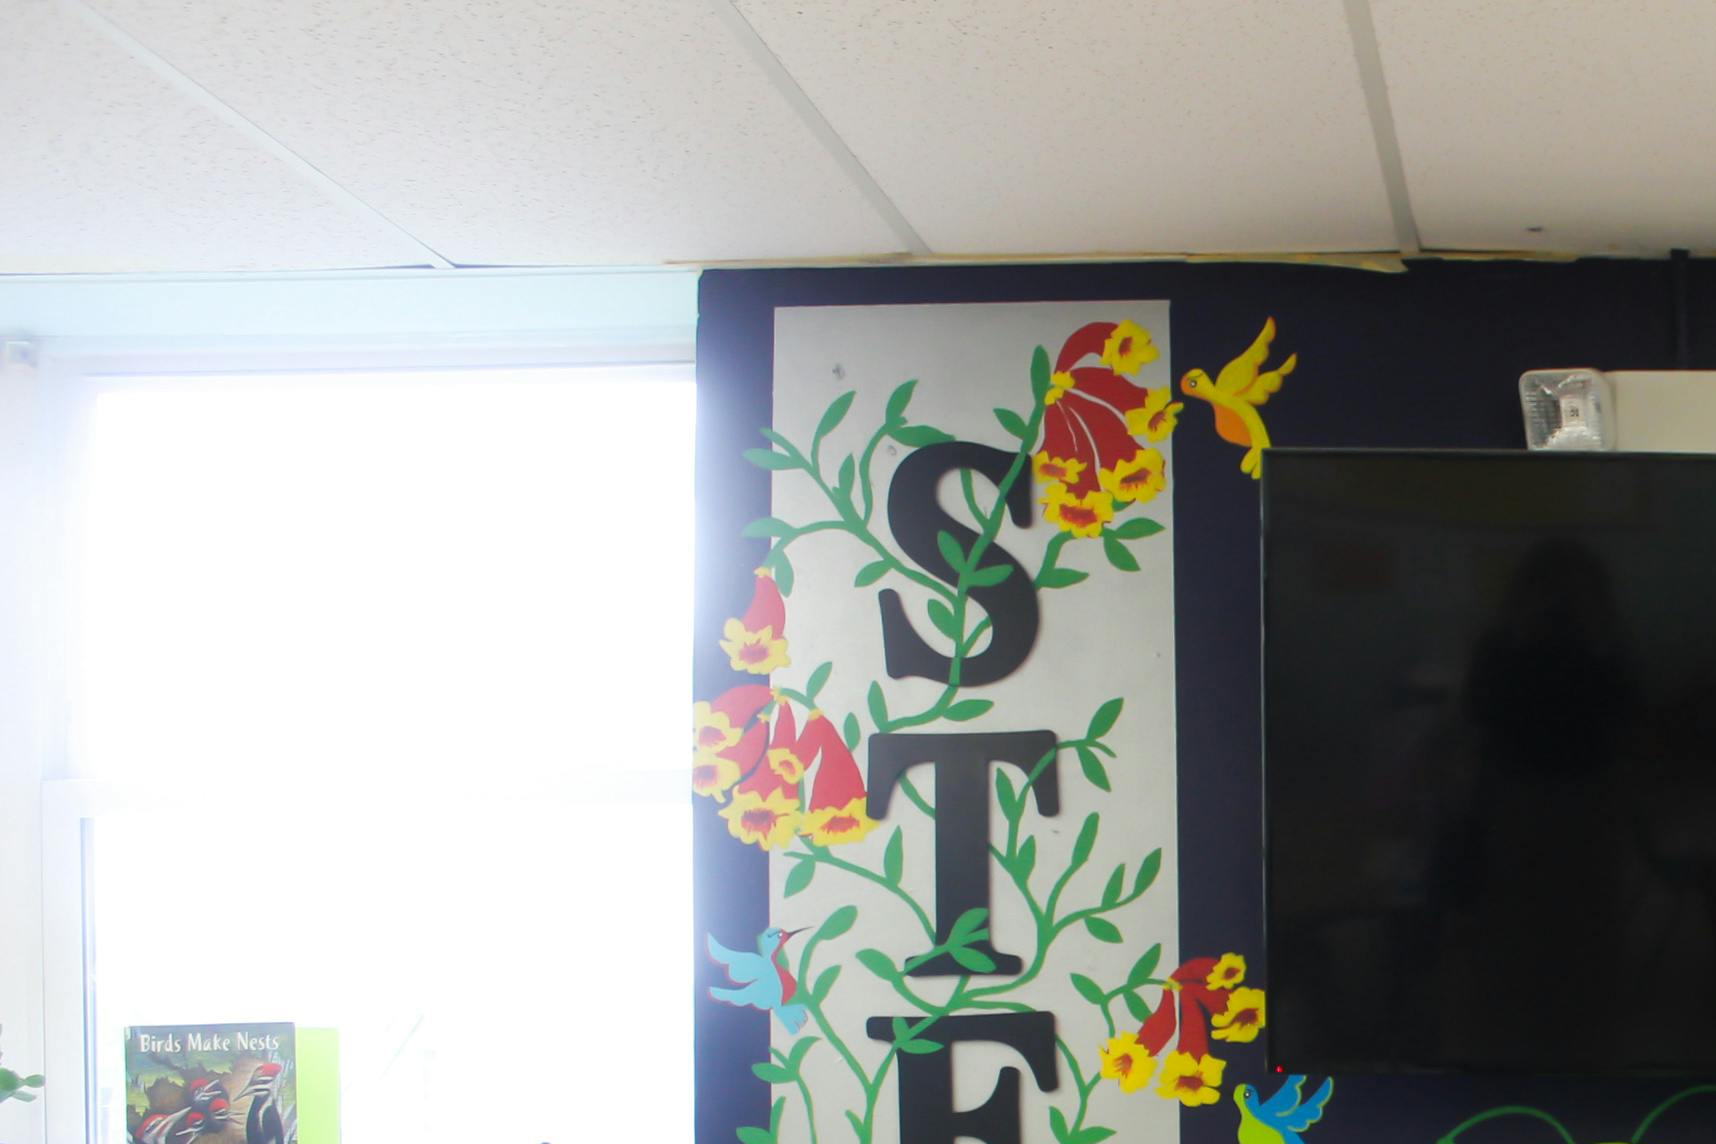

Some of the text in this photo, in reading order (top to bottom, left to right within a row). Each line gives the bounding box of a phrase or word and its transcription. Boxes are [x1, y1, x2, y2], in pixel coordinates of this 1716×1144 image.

[140, 1032, 279, 1052] Birds Make Nests
